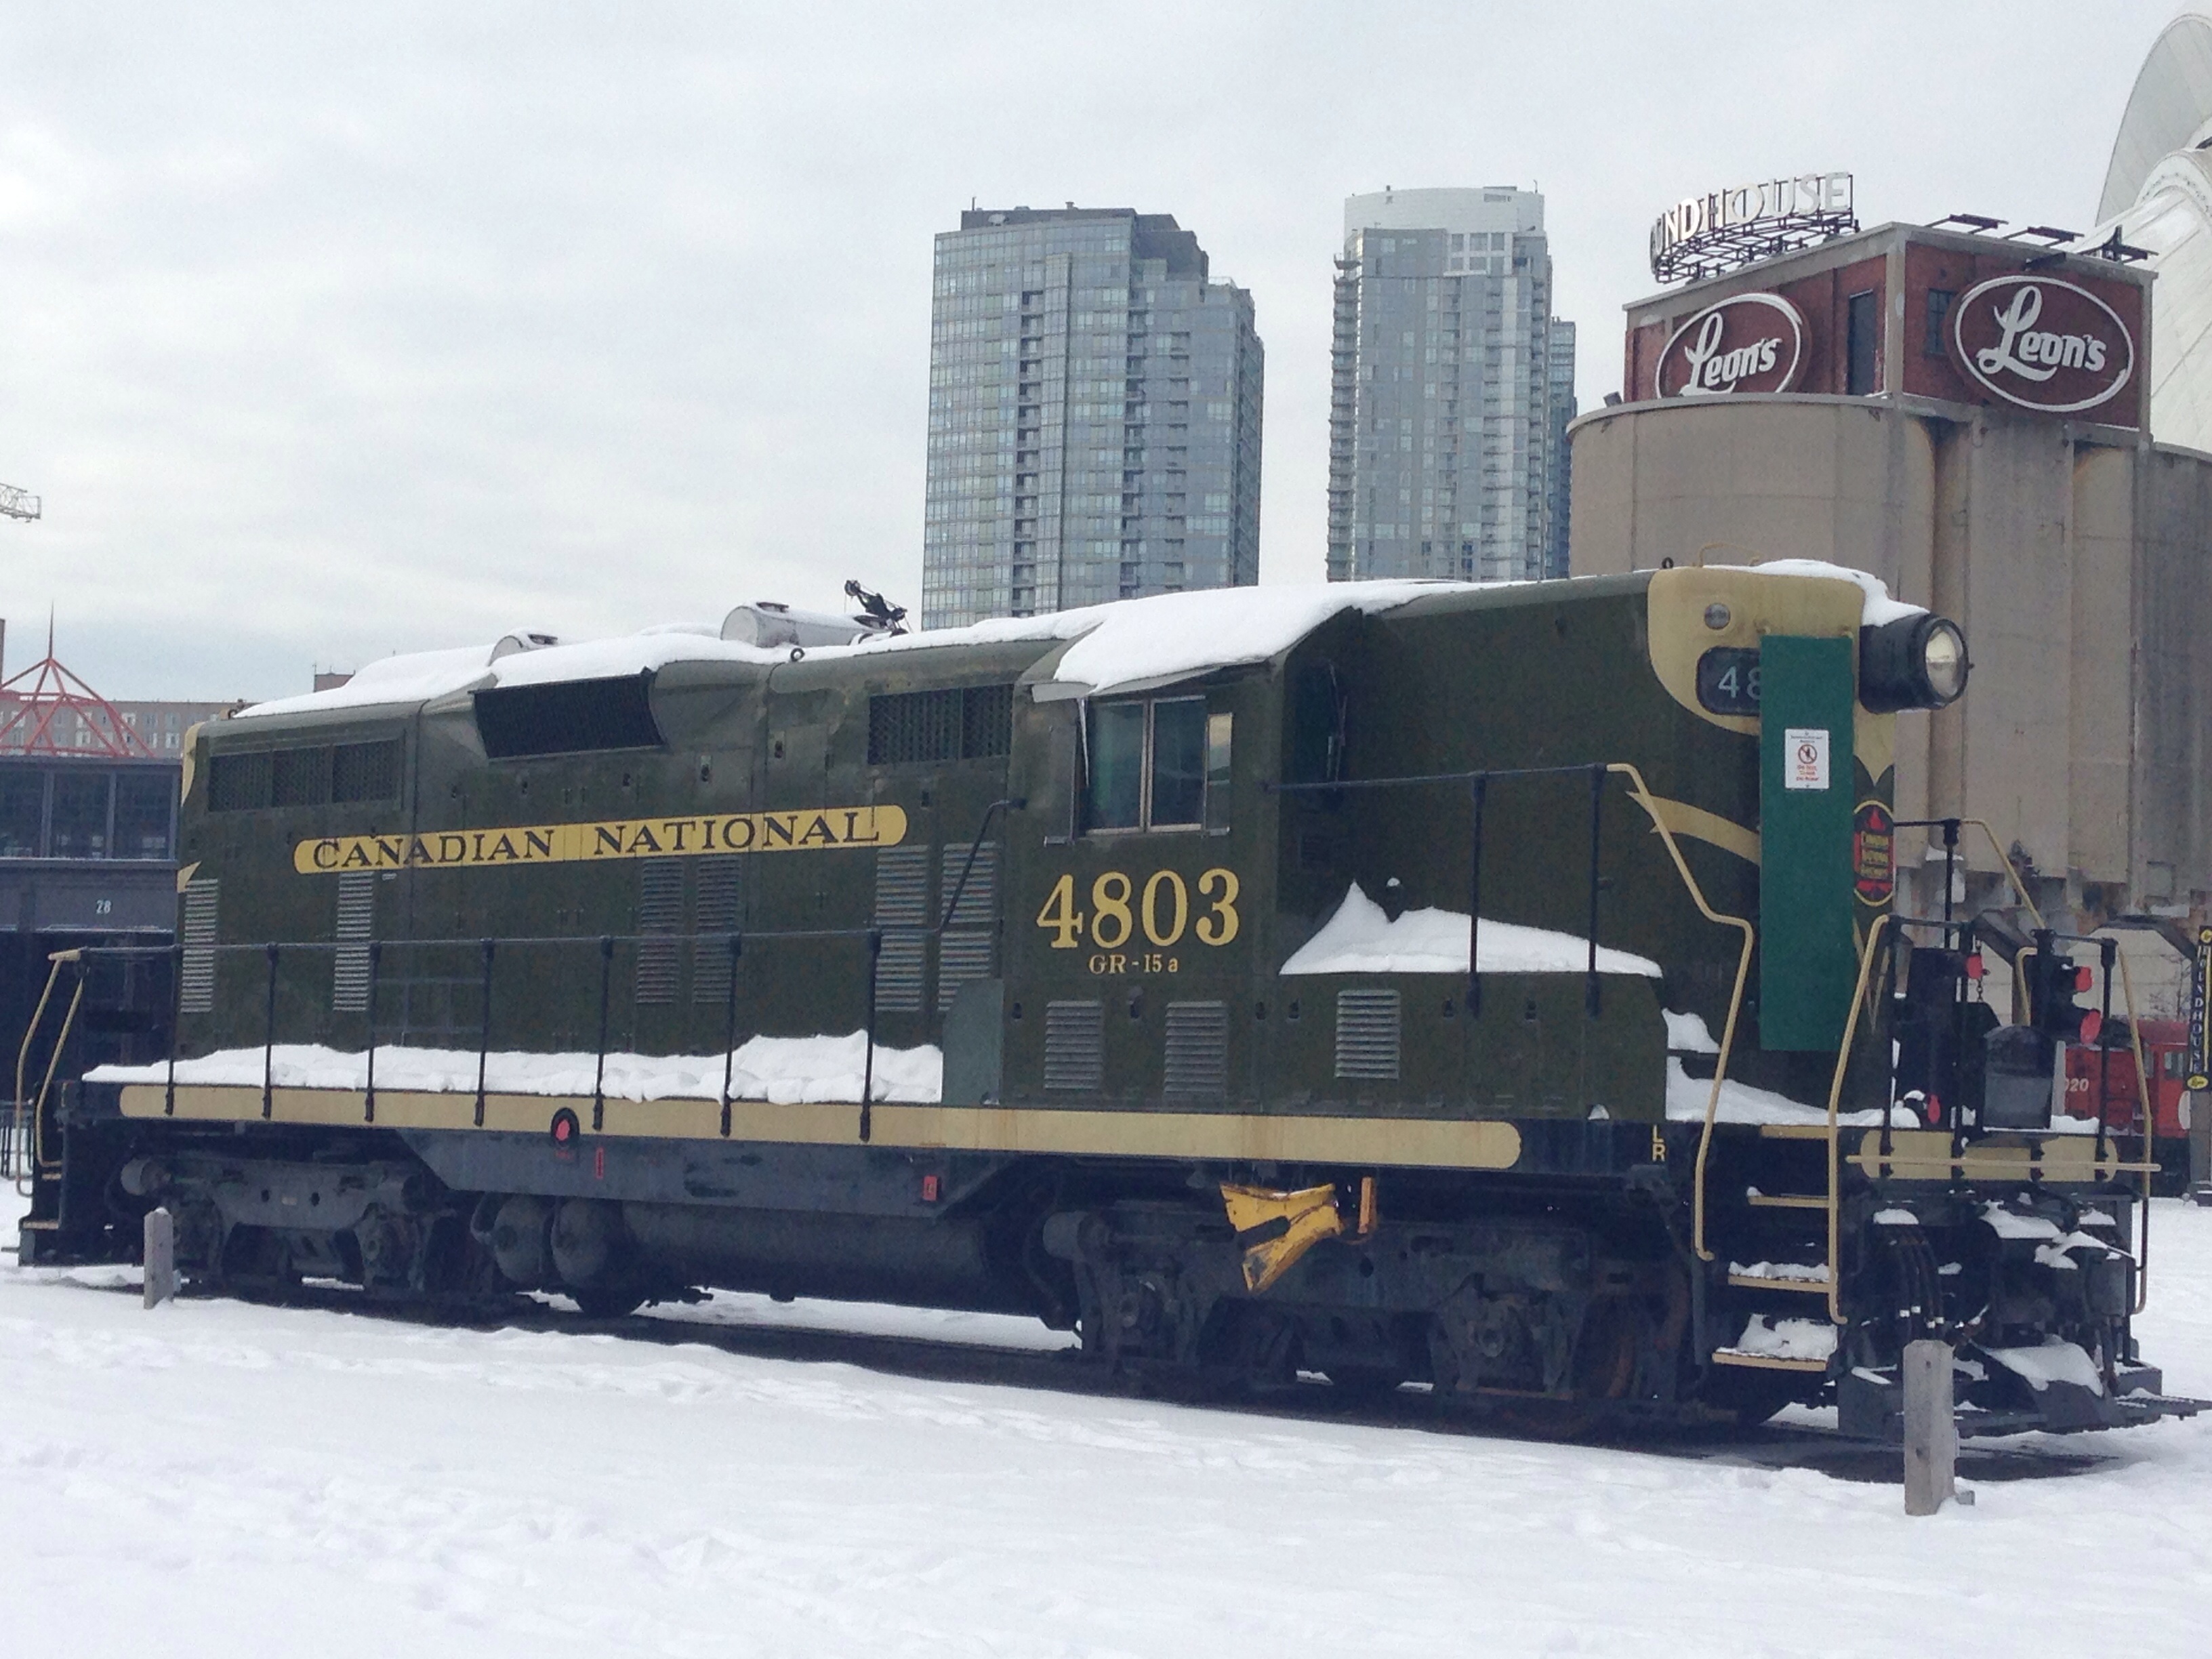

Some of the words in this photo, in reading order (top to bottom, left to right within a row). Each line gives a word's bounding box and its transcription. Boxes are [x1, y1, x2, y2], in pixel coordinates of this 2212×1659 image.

[1679, 312, 1782, 396] Leon's
[1976, 285, 2106, 381] Leon's
[313, 829, 554, 869] CANADIAN
[594, 812, 880, 855] NATIONAL
[96, 900, 112, 914] 28
[1036, 867, 1240, 949] 4803
